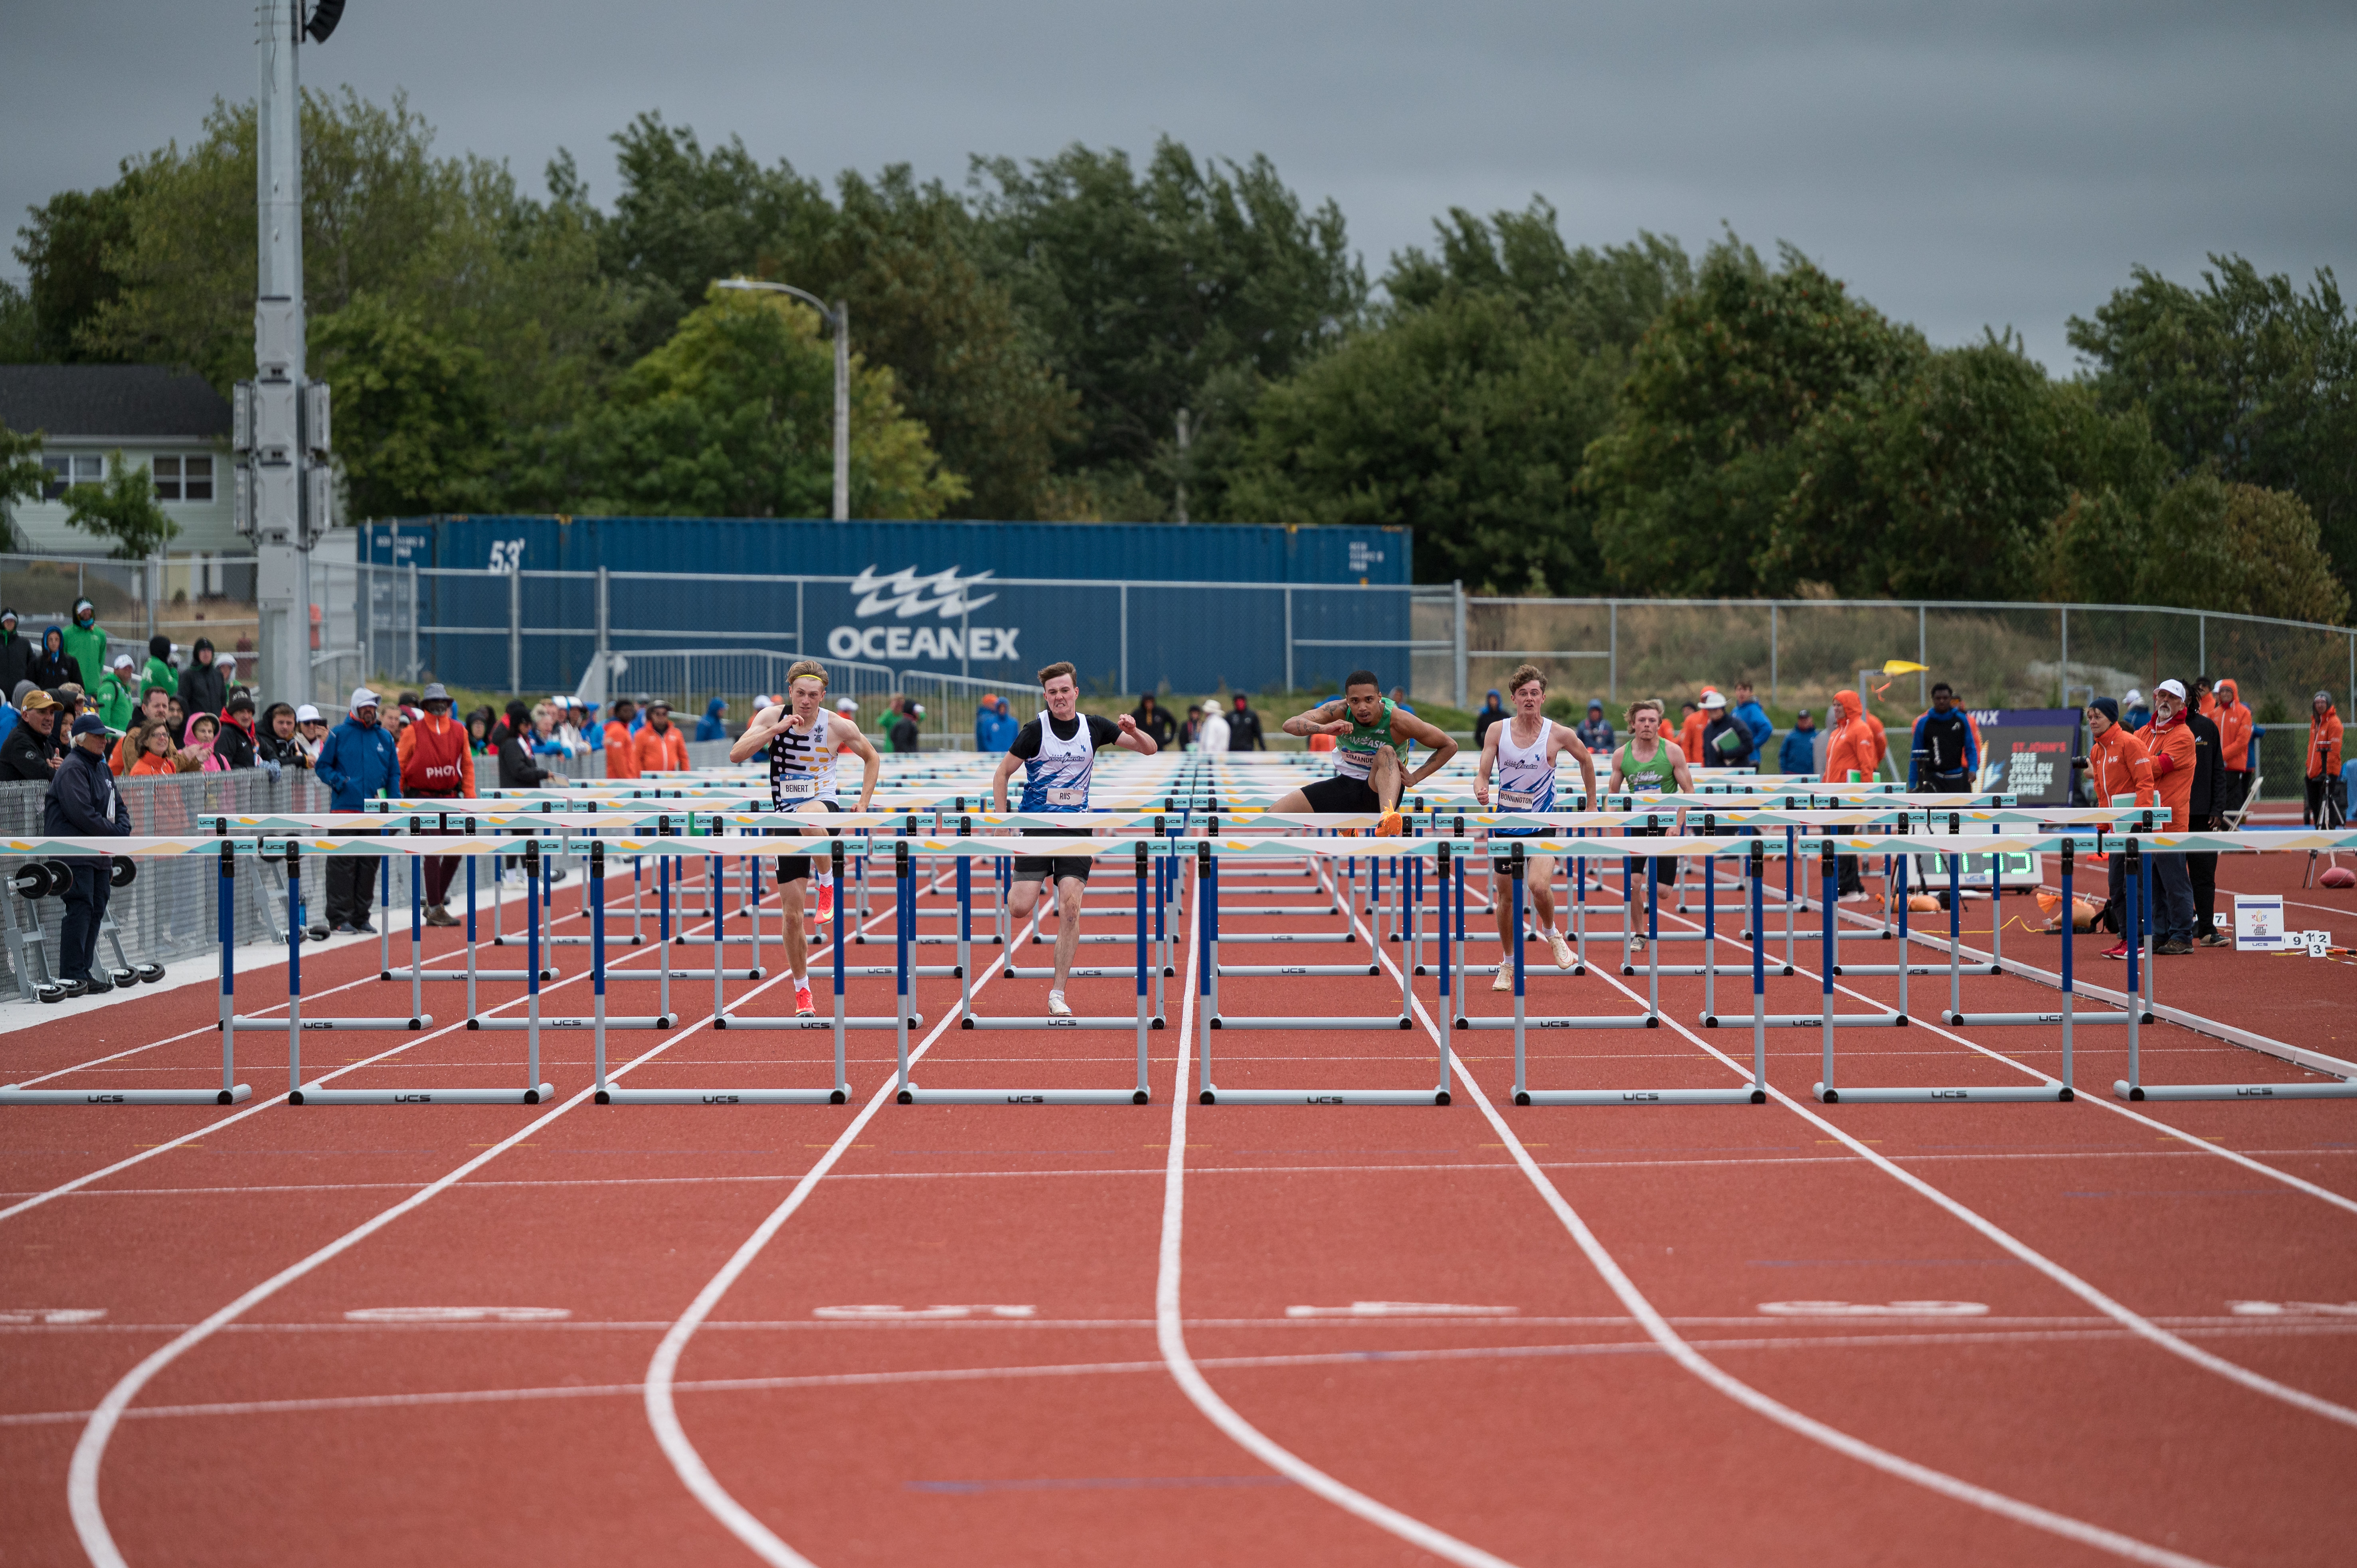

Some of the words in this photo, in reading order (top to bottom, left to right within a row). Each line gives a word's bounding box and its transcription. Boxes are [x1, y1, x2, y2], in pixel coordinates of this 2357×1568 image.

[828, 626, 1020, 660] OCEANEX
[2008, 773, 2052, 784] CANADA
[1500, 793, 1533, 804] BONNINGTON
[2293, 937, 2301, 945] 9
[2319, 934, 2327, 943] 2
[2313, 945, 2321, 954] 3
[2236, 1087, 2273, 1096] UCS
[87, 1094, 124, 1103] UCS
[702, 1095, 739, 1104] UCS
